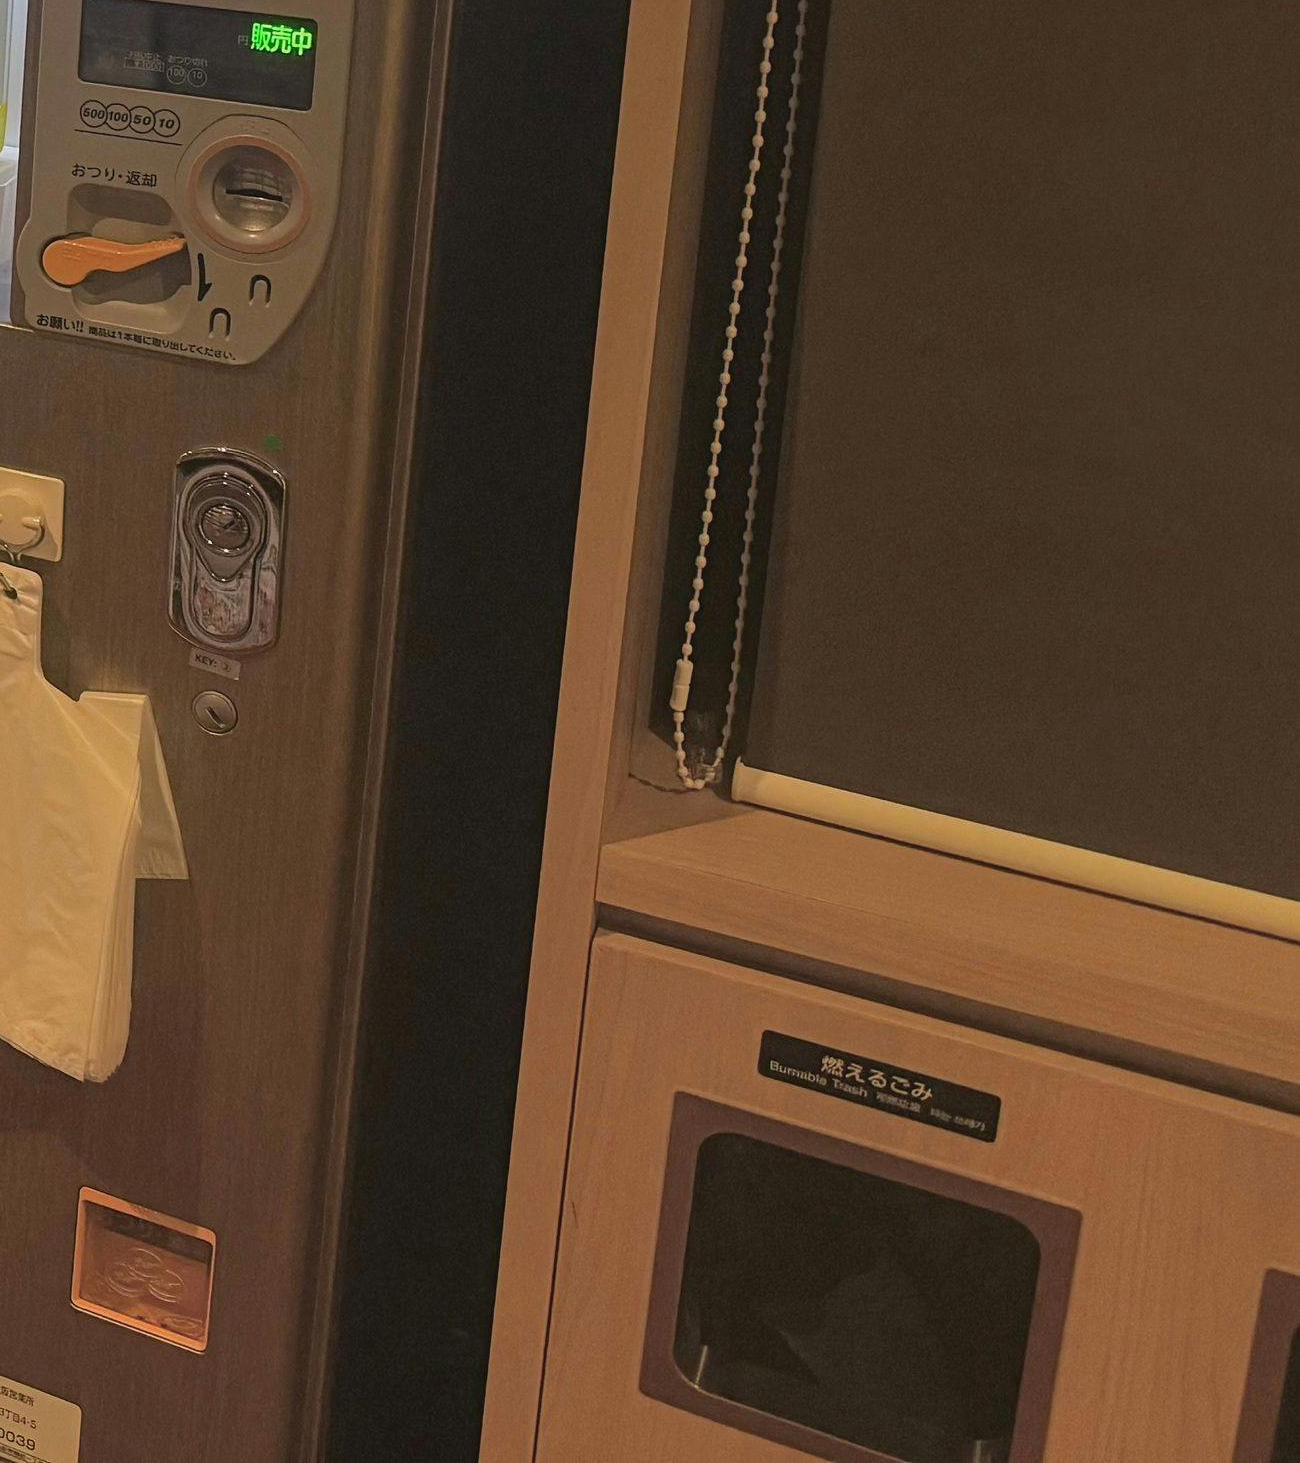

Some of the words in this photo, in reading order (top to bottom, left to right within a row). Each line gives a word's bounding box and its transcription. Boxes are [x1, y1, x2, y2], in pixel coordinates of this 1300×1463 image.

[251, 23, 313, 56] 販売中
[83, 107, 105, 121] 500
[108, 110, 129, 124] 100
[133, 113, 152, 126] 50
[159, 117, 175, 129] 10
[770, 1060, 828, 1086] Burnable
[832, 1078, 868, 1097] Trash
[821, 1054, 933, 1101] 燃えるごみ
